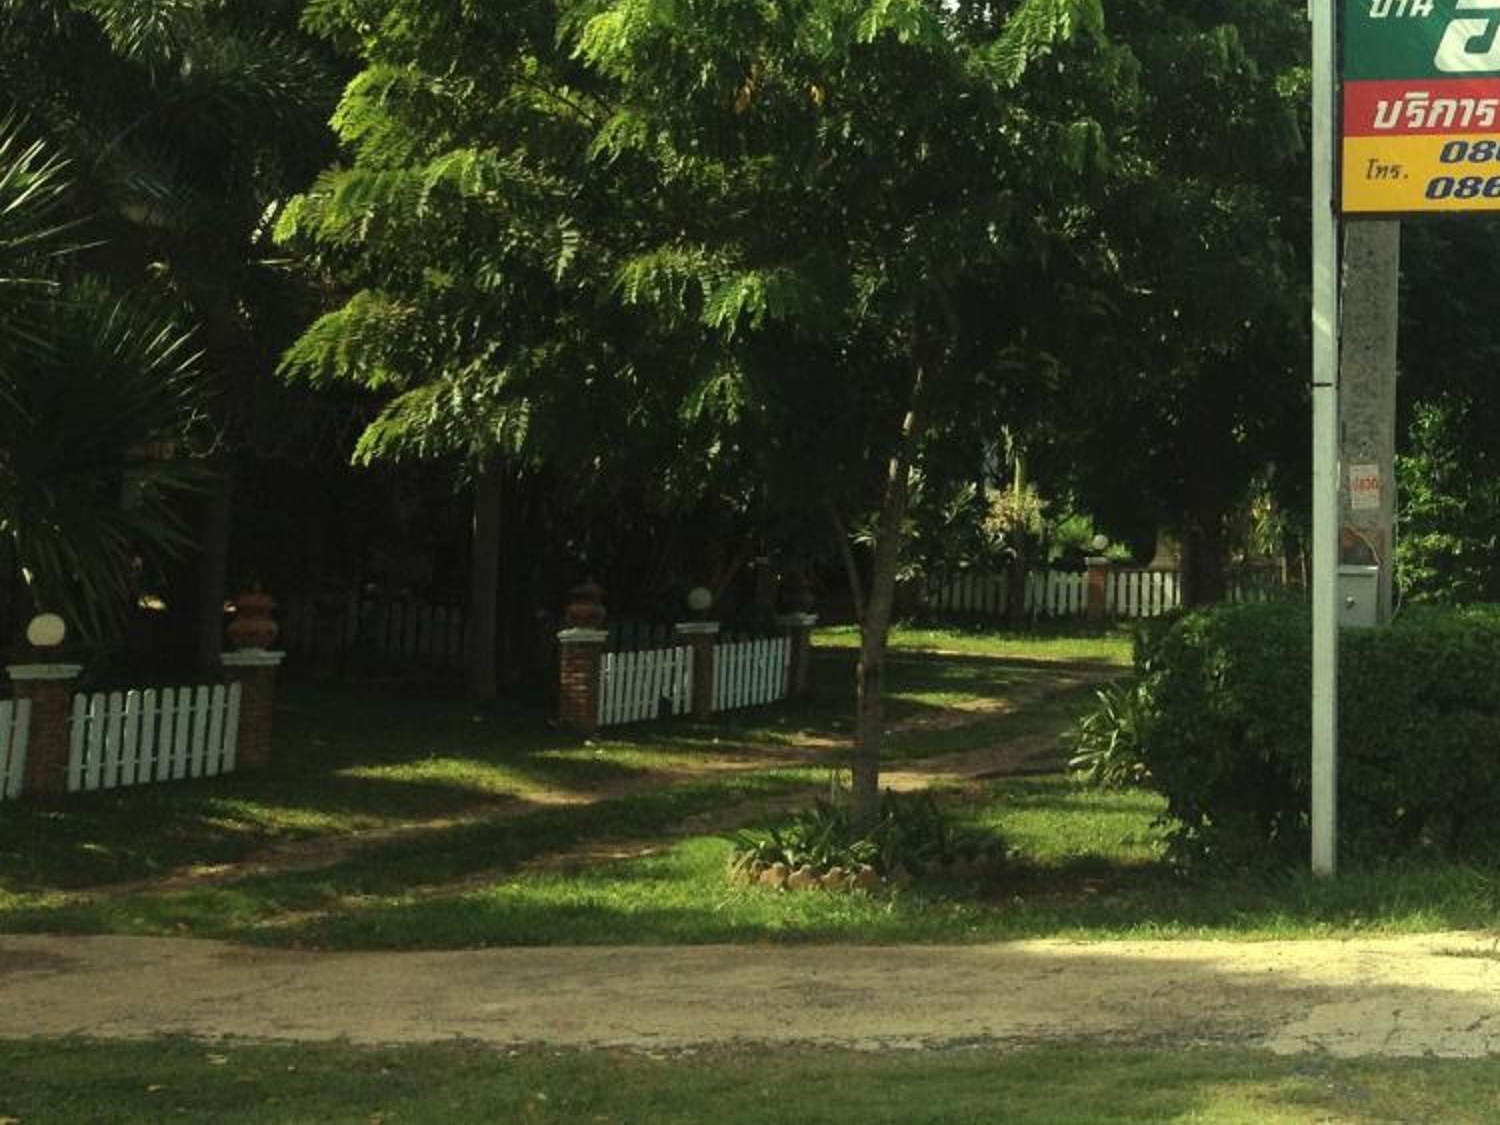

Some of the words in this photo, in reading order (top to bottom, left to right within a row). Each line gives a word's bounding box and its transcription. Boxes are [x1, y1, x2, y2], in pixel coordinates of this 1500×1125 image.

[1373, 91, 1499, 129] บริการ
[1366, 158, 1409, 181] โทร.
